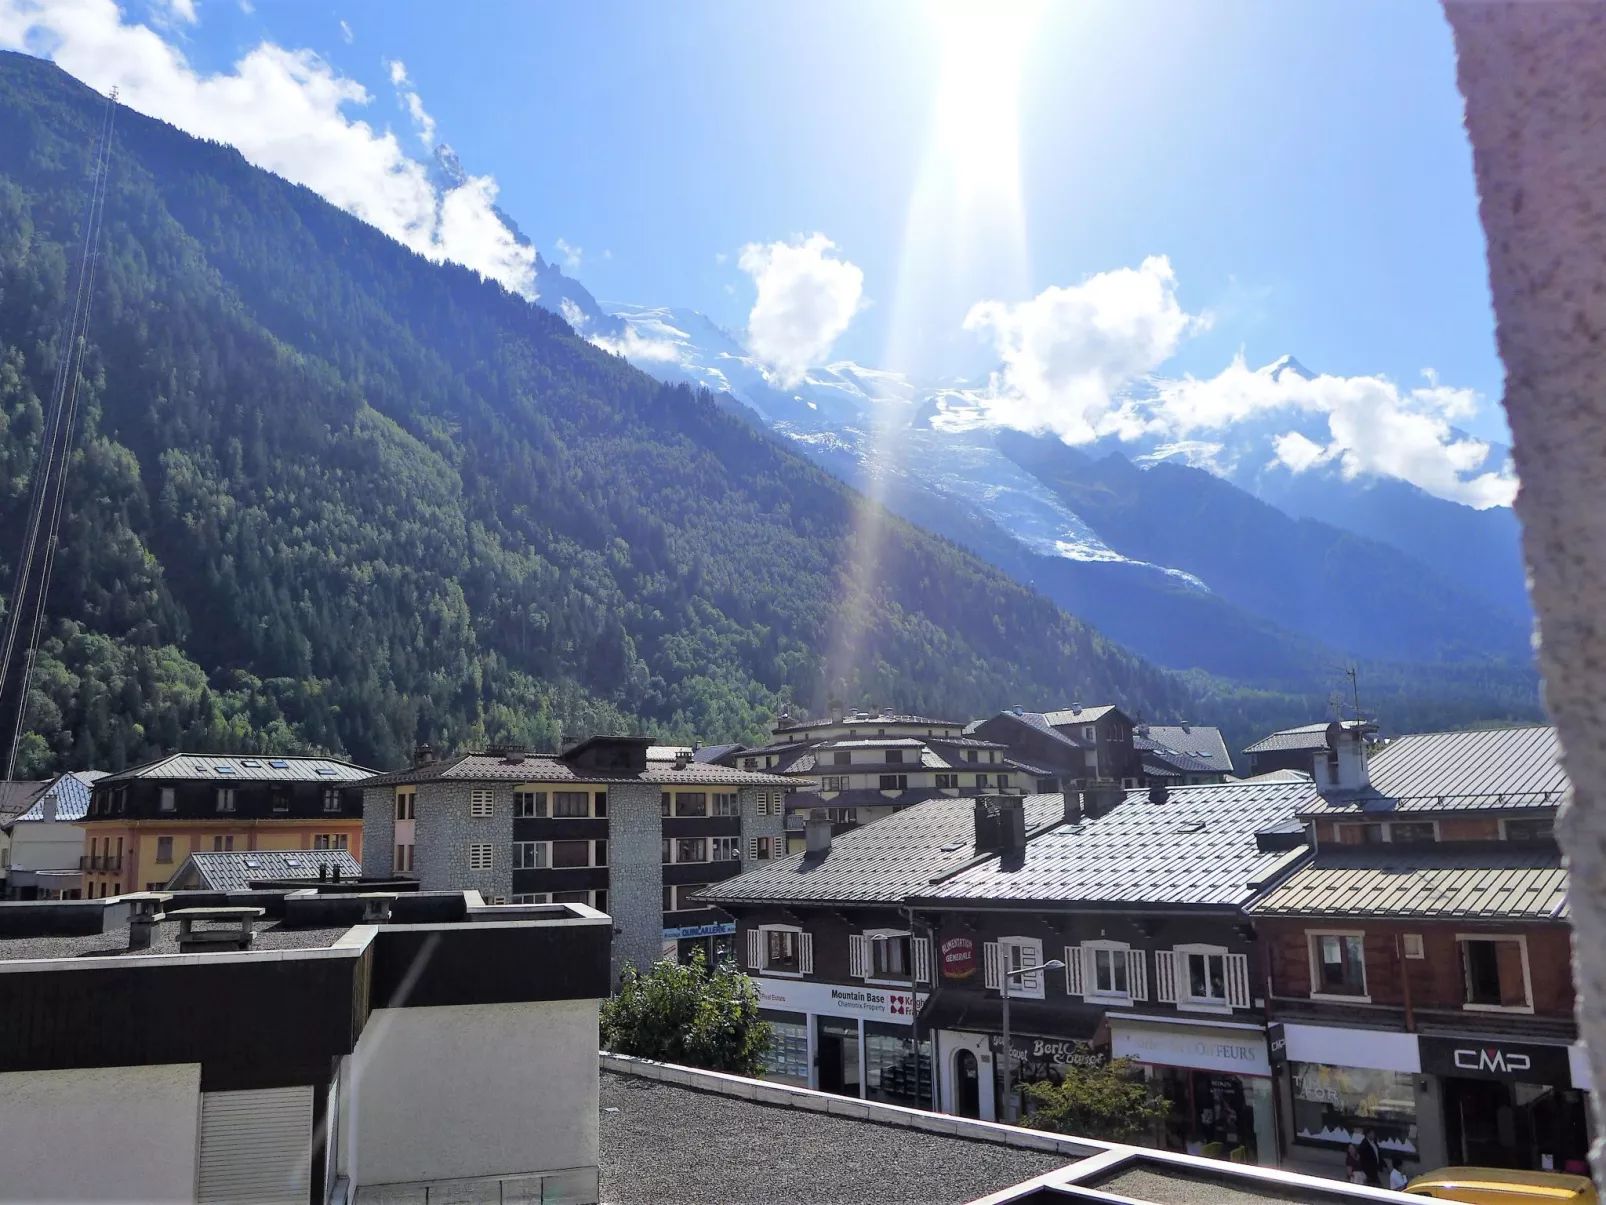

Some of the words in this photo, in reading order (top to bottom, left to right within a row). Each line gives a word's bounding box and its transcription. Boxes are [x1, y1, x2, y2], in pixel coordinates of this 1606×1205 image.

[682, 924, 727, 937] QUINCAILLERIE
[831, 989, 865, 1002] Mountain
[866, 993, 885, 1003] Base
[837, 1000, 863, 1009] Chamonix
[863, 1003, 886, 1013] Property
[1271, 1038, 1285, 1051] CMP
[1453, 1048, 1531, 1073] CMP
